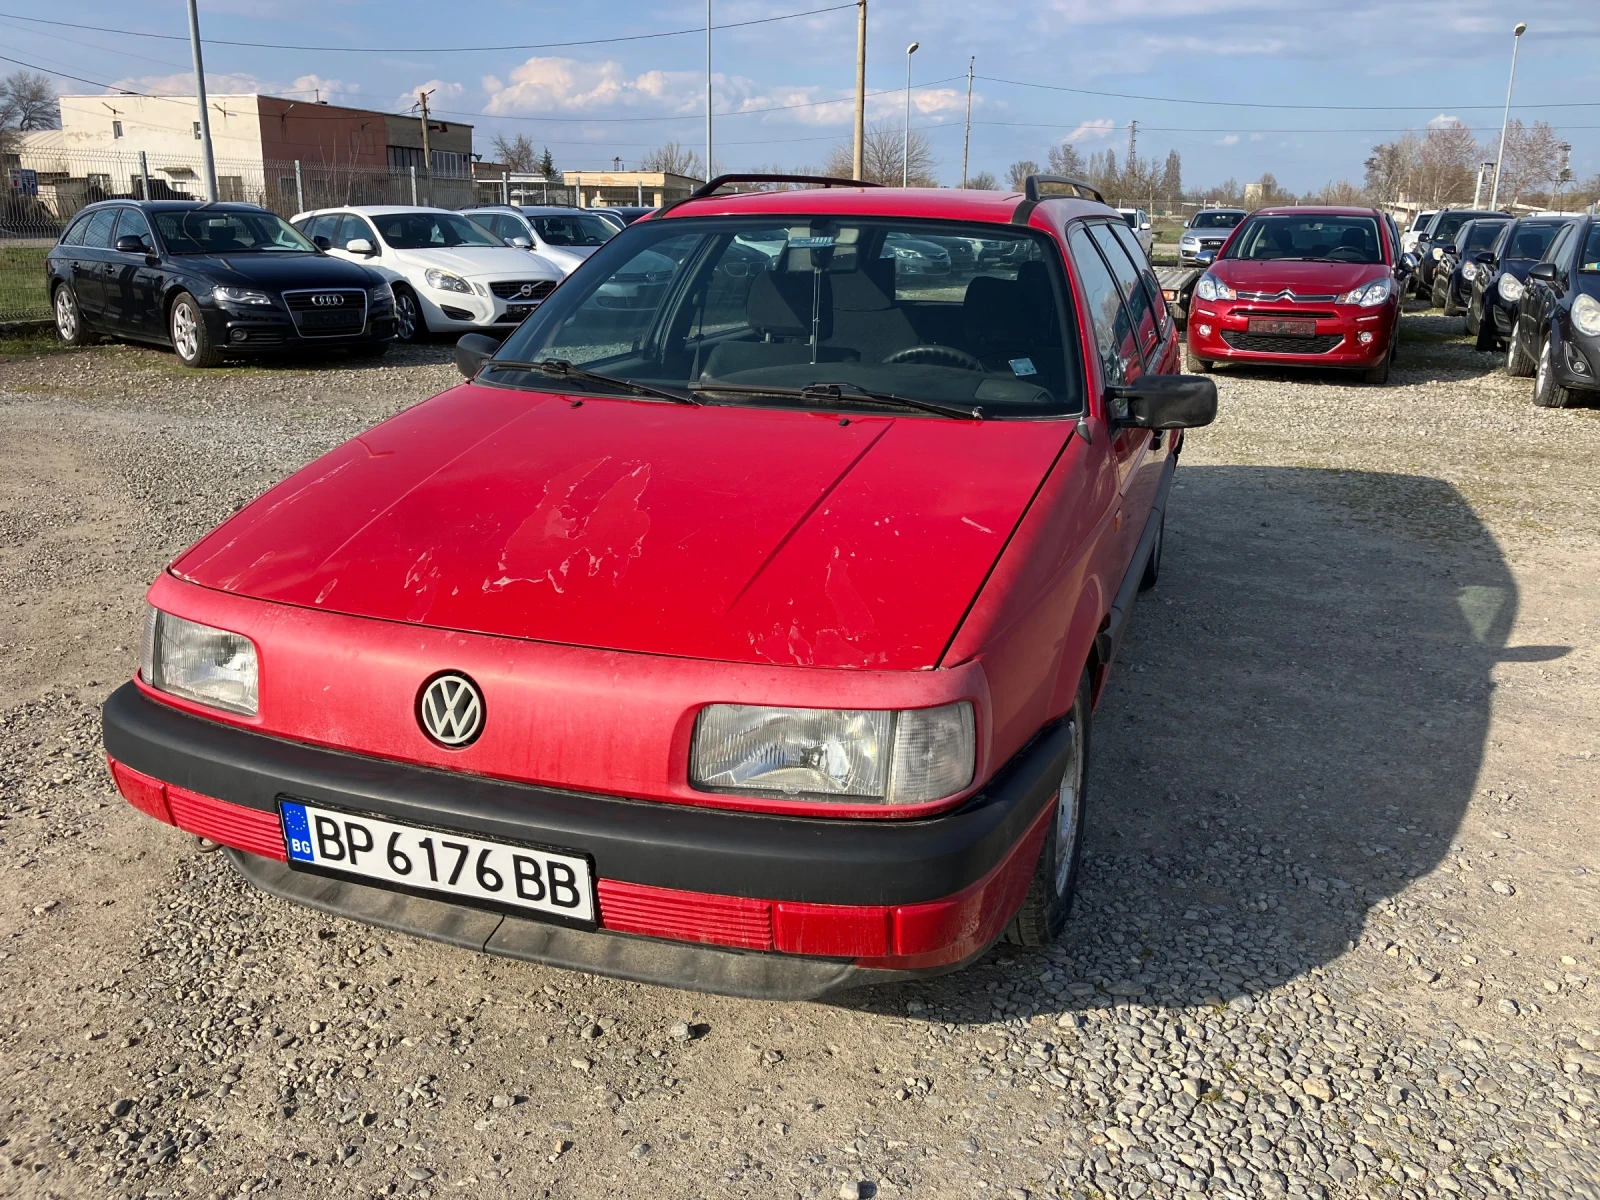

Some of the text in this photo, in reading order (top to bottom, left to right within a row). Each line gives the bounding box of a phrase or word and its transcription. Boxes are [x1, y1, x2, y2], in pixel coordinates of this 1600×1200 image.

[291, 838, 312, 855] BG
[386, 831, 504, 893] 6176
[513, 854, 581, 909] BB
